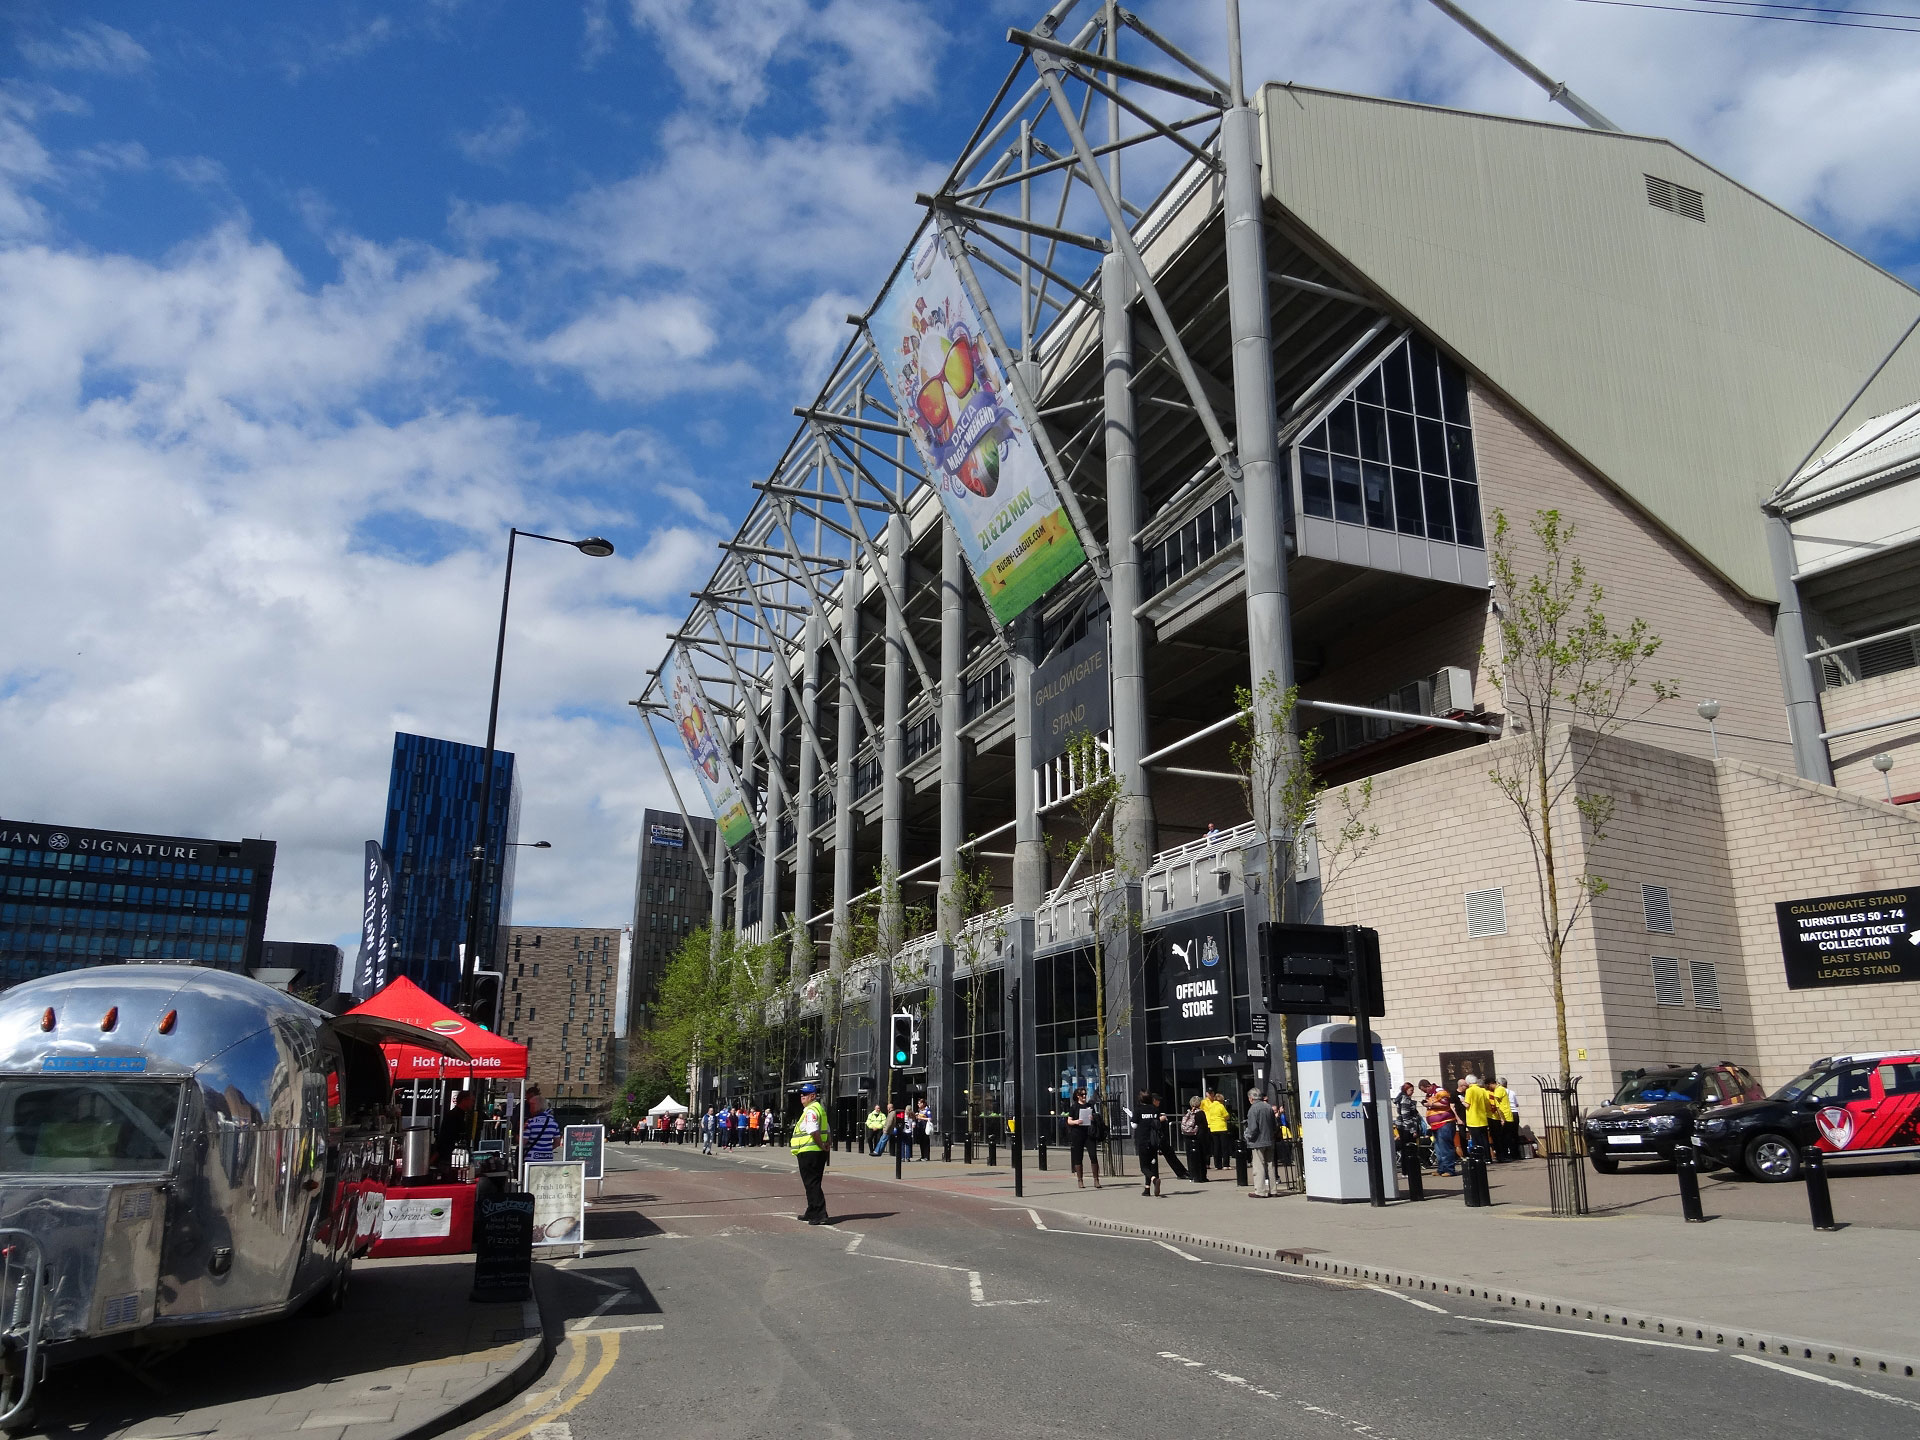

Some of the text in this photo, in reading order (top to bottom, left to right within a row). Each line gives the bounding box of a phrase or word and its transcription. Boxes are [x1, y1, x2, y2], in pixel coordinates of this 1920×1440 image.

[951, 404, 977, 447] DACIA
[946, 406, 996, 471] MAGIC WEEKEND
[977, 485, 1034, 552] 21 & 22 MAY
[996, 524, 1047, 574] RUGBY-LEAGUE.COM
[1035, 650, 1103, 707] GALLOWGATE
[1051, 703, 1086, 736] STAND
[78, 837, 199, 860] SIGNATURE
[1790, 894, 1907, 915] GALLOWGATE STAND
[1797, 912, 1866, 928] TURNSTILES
[1867, 911, 1881, 921] 50
[1889, 909, 1904, 919] 74
[1799, 923, 1906, 942] MATCH DAY TICKET
[1818, 936, 1891, 951] COLLECTION
[1822, 950, 1891, 965] EAST STAND
[1817, 964, 1901, 979] LEAZES STAND
[1176, 979, 1219, 1000] OFFICIAL
[1182, 999, 1214, 1019] STORE
[45, 1060, 143, 1069] AIRSTREAM
[412, 1056, 435, 1067] Hot
[1312, 1155, 1327, 1163] Secure
[1353, 1155, 1368, 1163] Secu
[536, 1183, 554, 1191] Fresh
[556, 1192, 578, 1200] Coffee
[383, 1206, 426, 1232] Supreme
